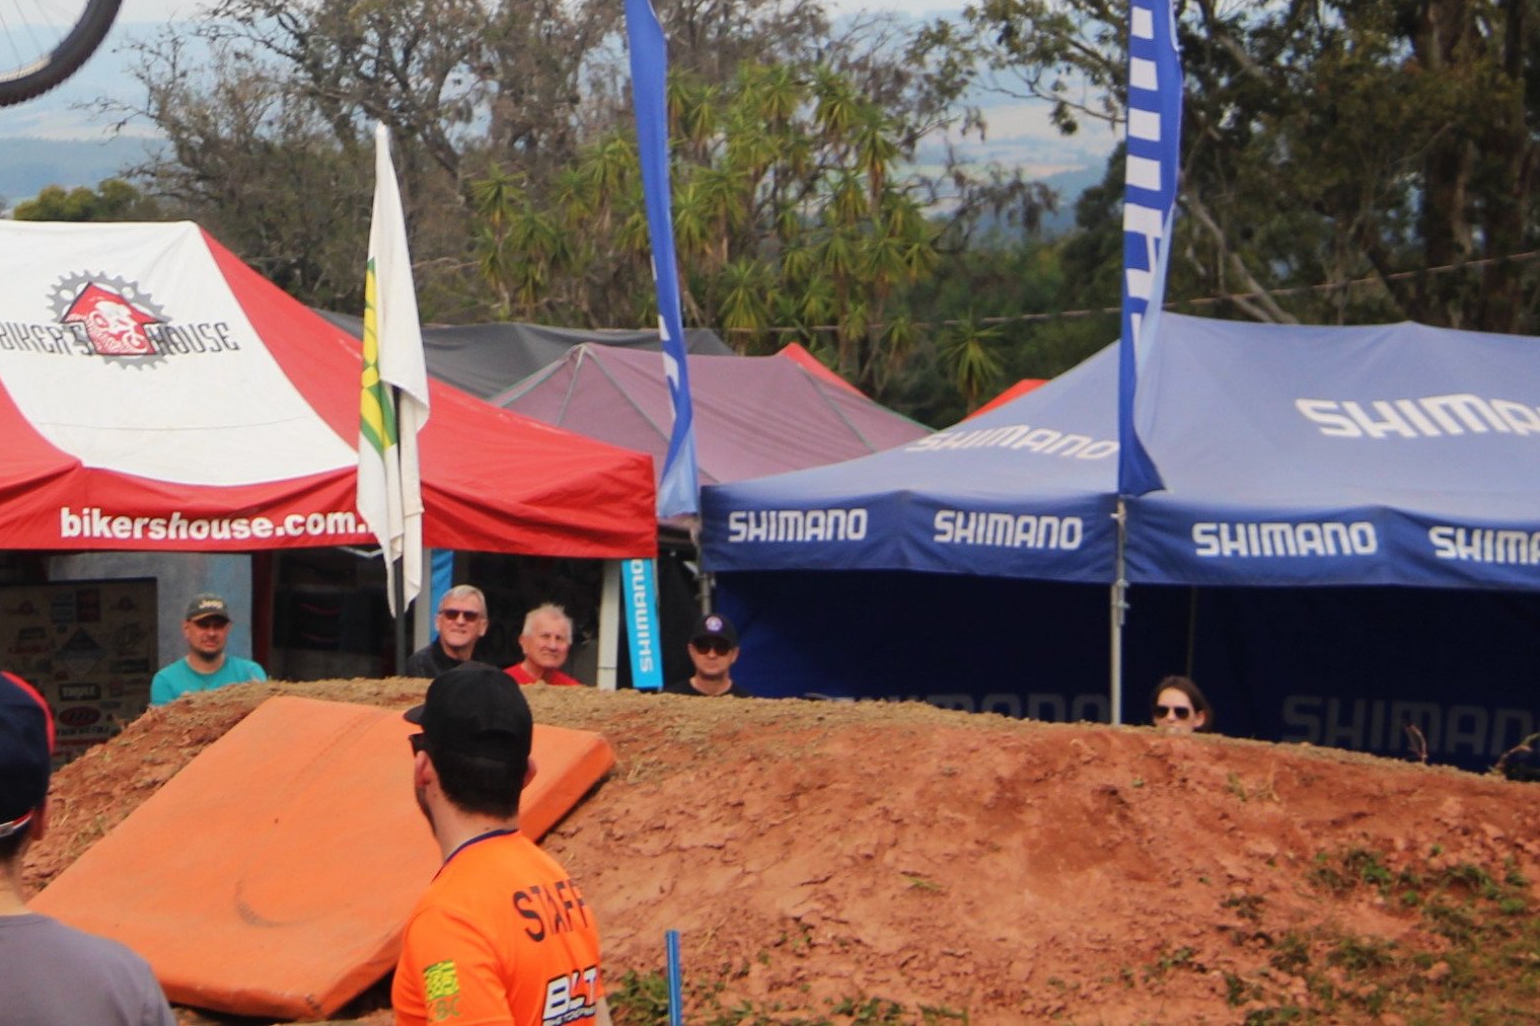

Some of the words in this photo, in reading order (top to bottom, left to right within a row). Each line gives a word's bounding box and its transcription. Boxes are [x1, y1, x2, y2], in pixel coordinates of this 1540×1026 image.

[147, 321, 241, 357] HOUSE
[905, 424, 1120, 460] SHIMANO
[60, 507, 371, 540] bikershouse.com.
[728, 508, 868, 542] SHIMANO
[934, 510, 1083, 550] SHIMANO
[1192, 522, 1378, 557] SHIMANO
[630, 559, 653, 672] SHIMANO
[1282, 694, 1540, 758] SHIMAN
[513, 881, 589, 942] STAFF
